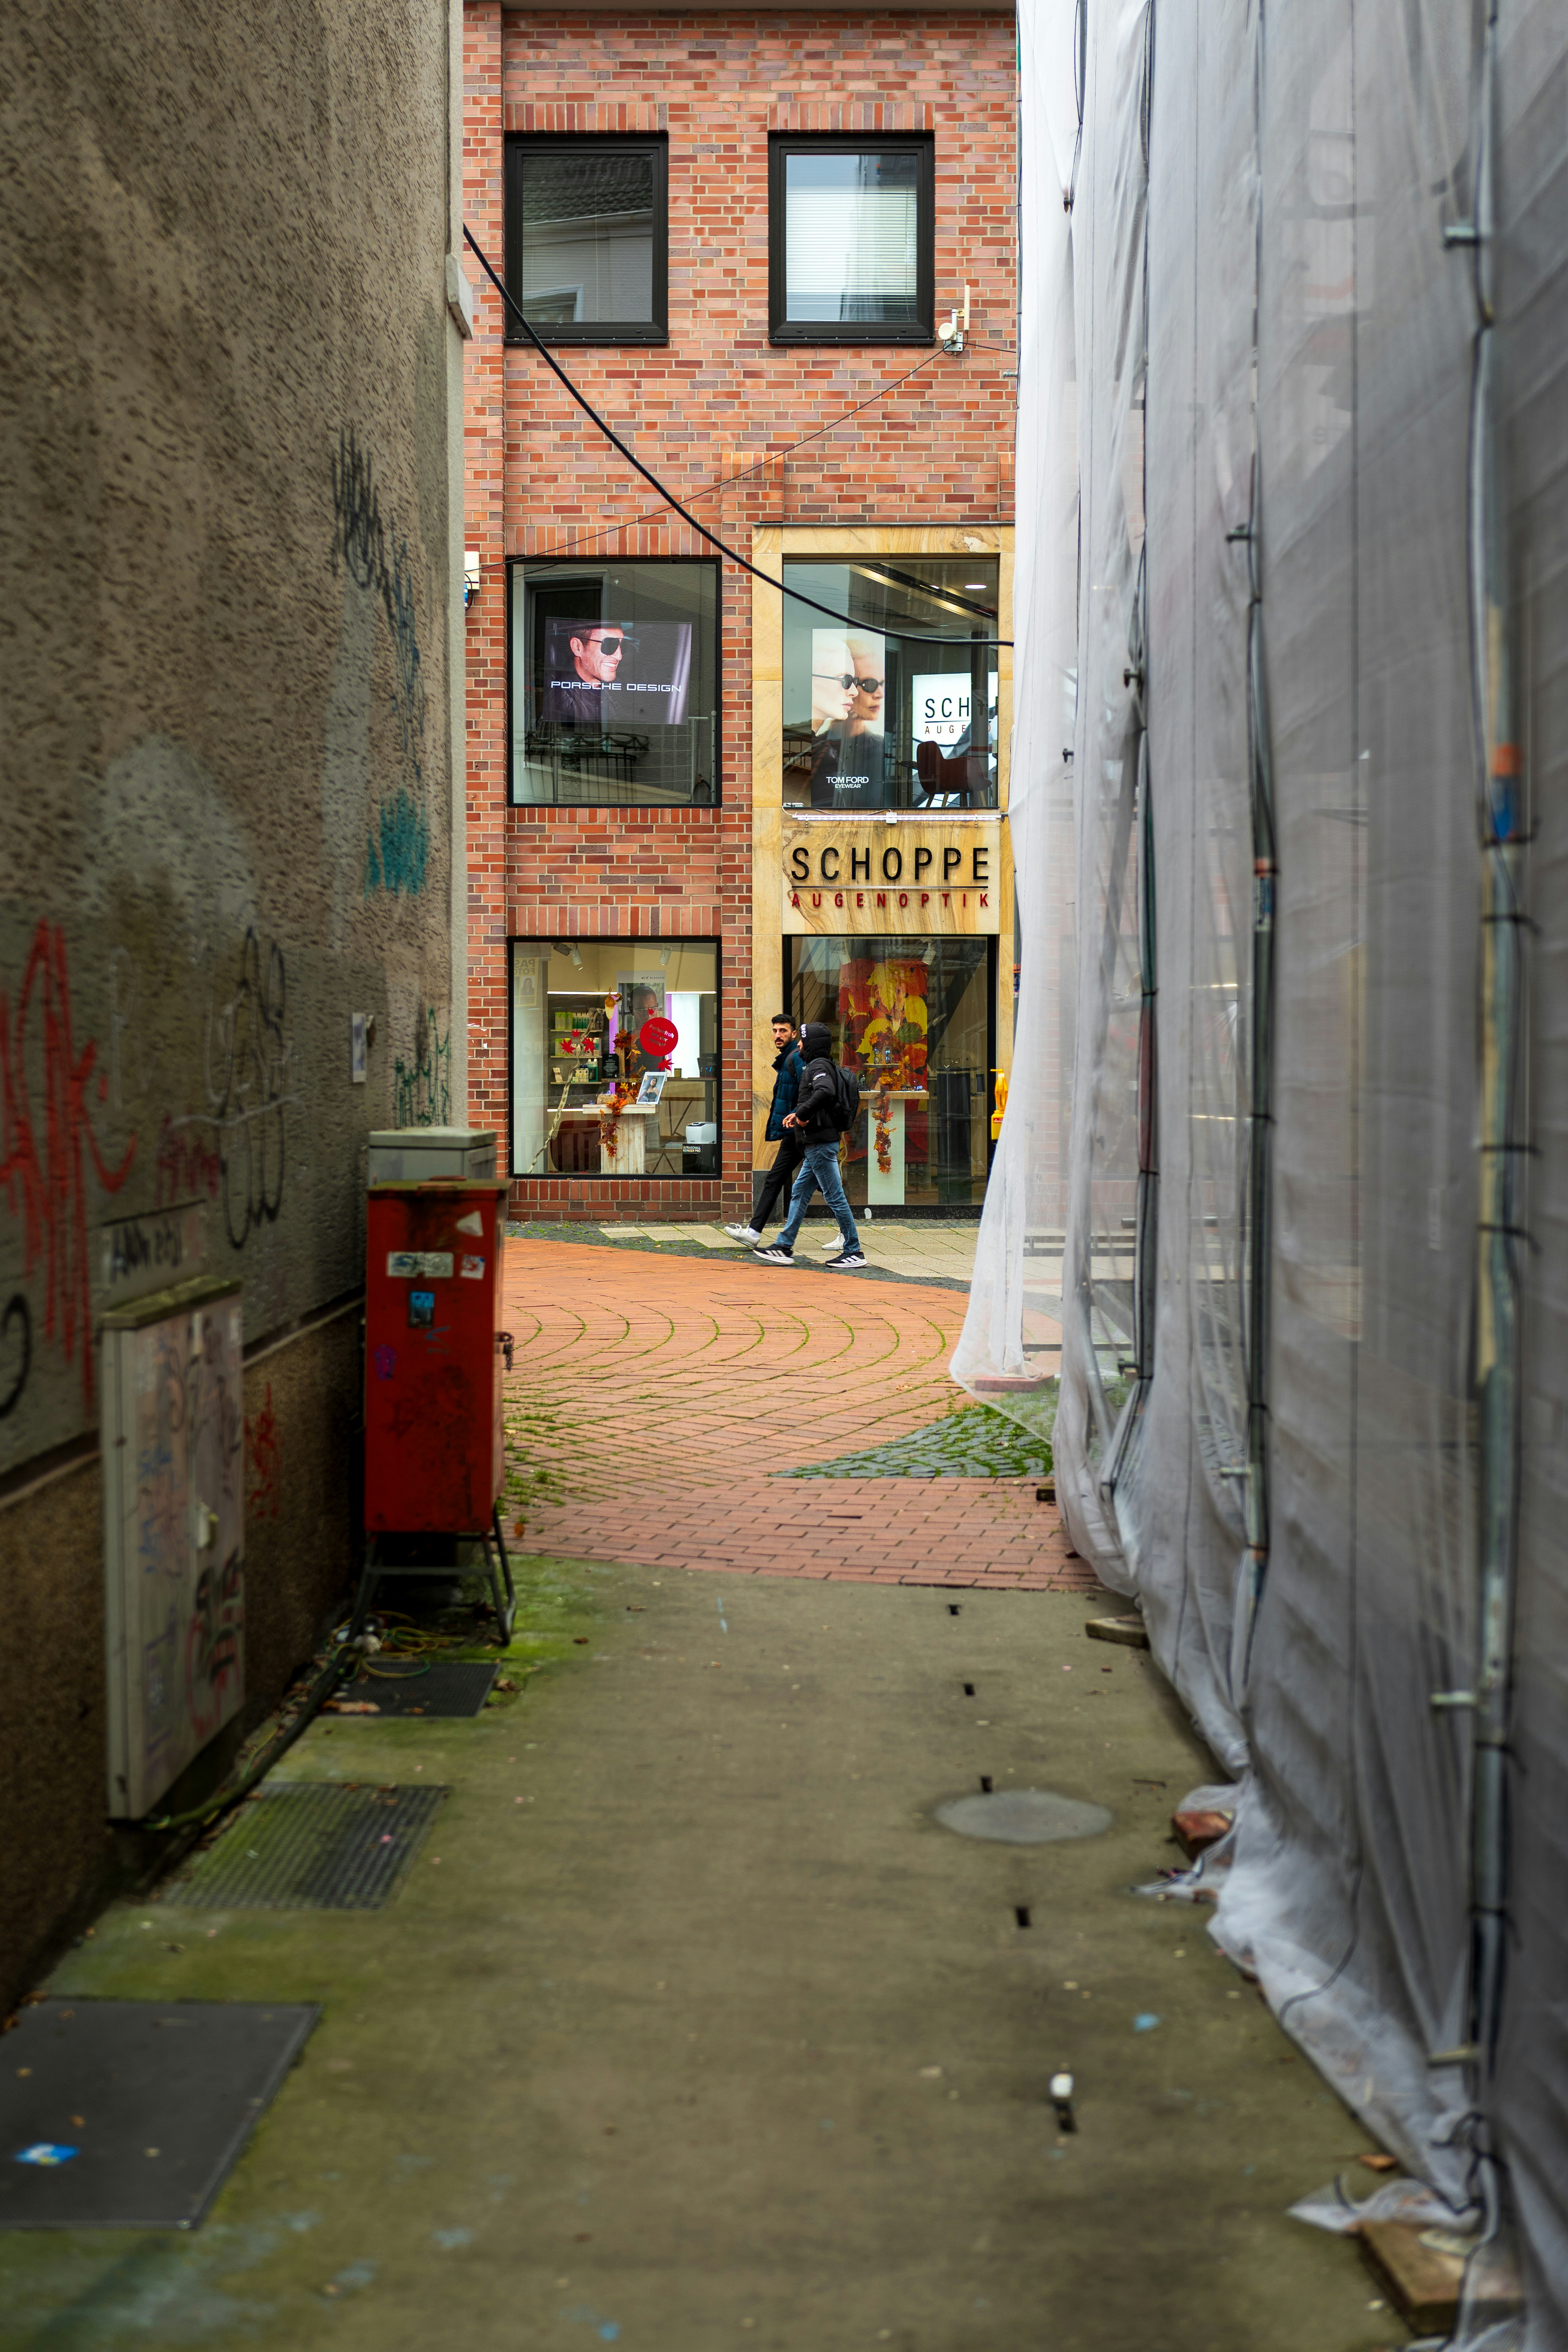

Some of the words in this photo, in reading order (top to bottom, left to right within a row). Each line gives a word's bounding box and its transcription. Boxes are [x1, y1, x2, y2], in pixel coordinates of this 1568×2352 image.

[551, 681, 622, 690] PORSCHE
[626, 683, 681, 692] DESIGN
[791, 847, 989, 880] SCHOPPE
[791, 893, 989, 907] AUGENOPTIK
